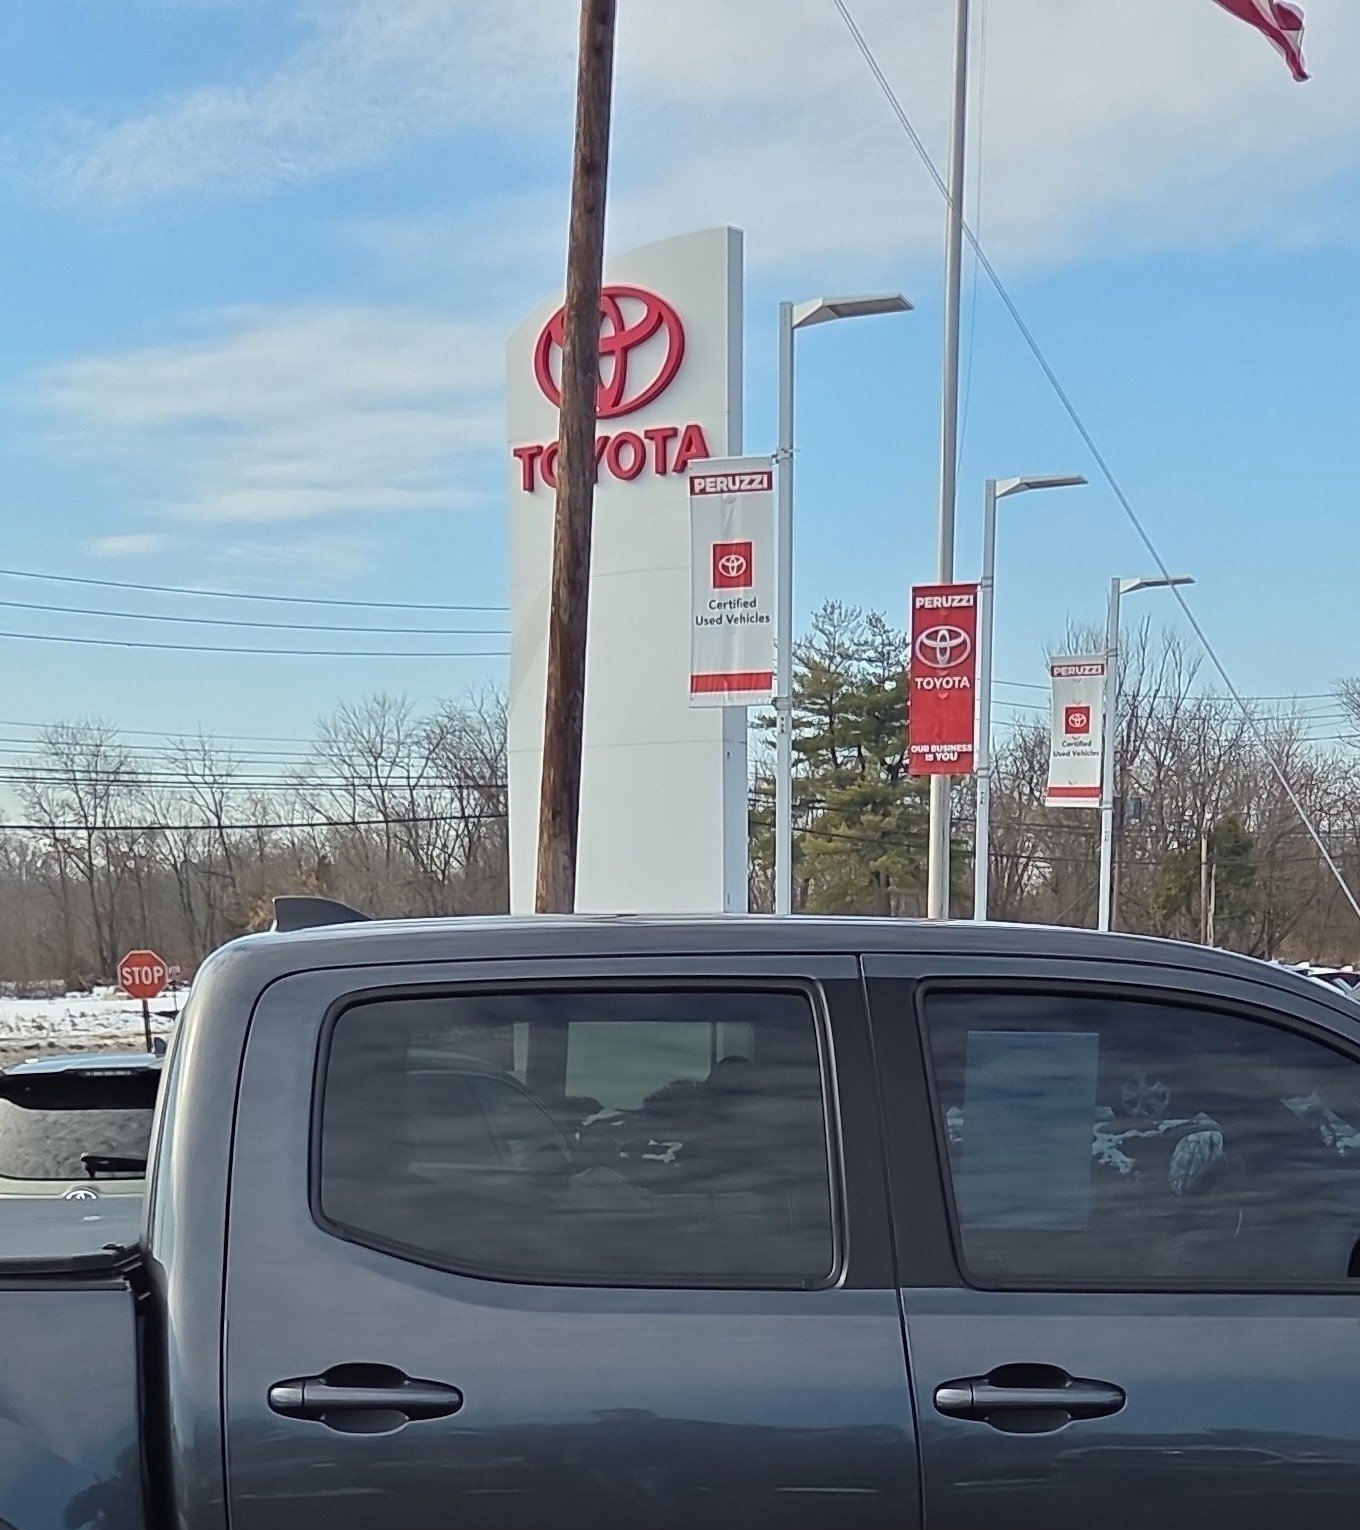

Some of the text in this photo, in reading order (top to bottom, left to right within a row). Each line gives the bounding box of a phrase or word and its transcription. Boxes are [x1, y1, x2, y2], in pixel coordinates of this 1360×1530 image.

[693, 474, 768, 494] PERUZZI
[708, 597, 757, 611] Certified
[915, 594, 974, 609] PERUZZI
[695, 611, 771, 627] Used Vehicles
[1053, 665, 1102, 677] PERUZZI
[915, 676, 971, 690] TOYOTA
[911, 744, 929, 753] OUR
[925, 752, 958, 762] IS YOU
[122, 965, 163, 986] STOP
